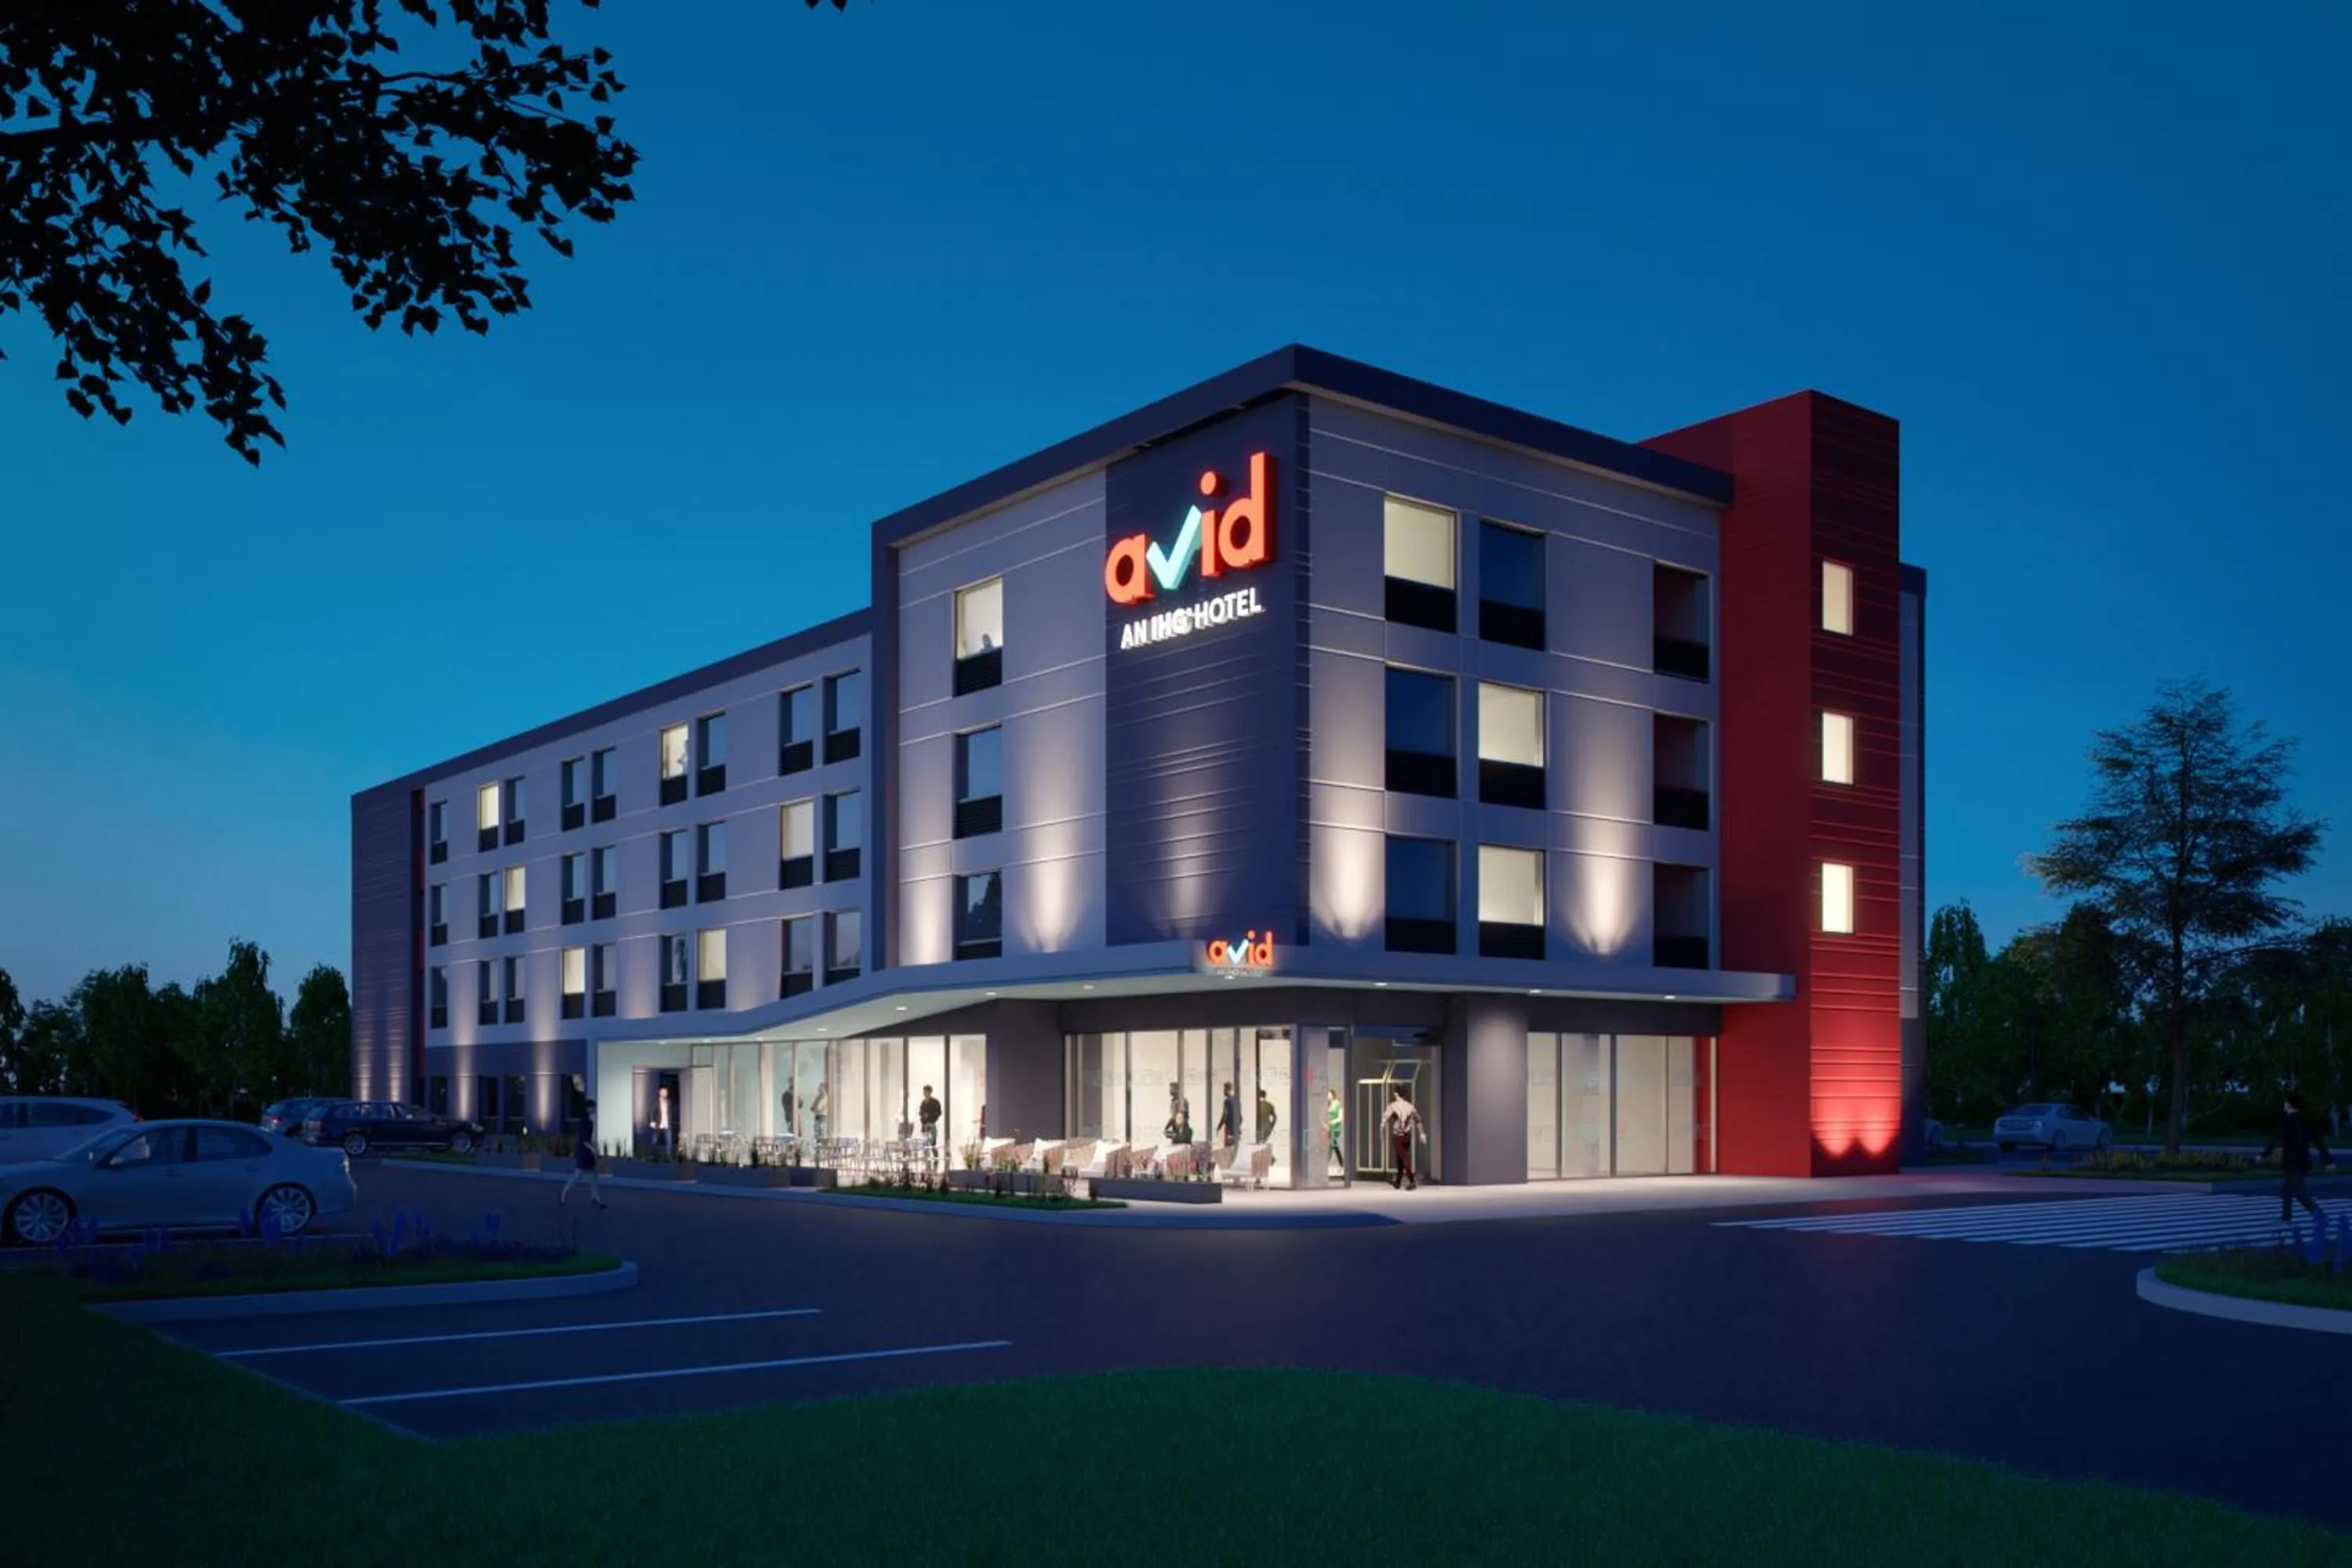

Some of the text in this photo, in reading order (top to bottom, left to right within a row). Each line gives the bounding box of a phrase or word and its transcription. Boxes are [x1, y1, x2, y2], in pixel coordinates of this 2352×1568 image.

[1105, 452, 1269, 604] avid
[1120, 618, 1149, 649] AN
[1194, 586, 1262, 630] HOTEL
[1208, 930, 1273, 967] avid
